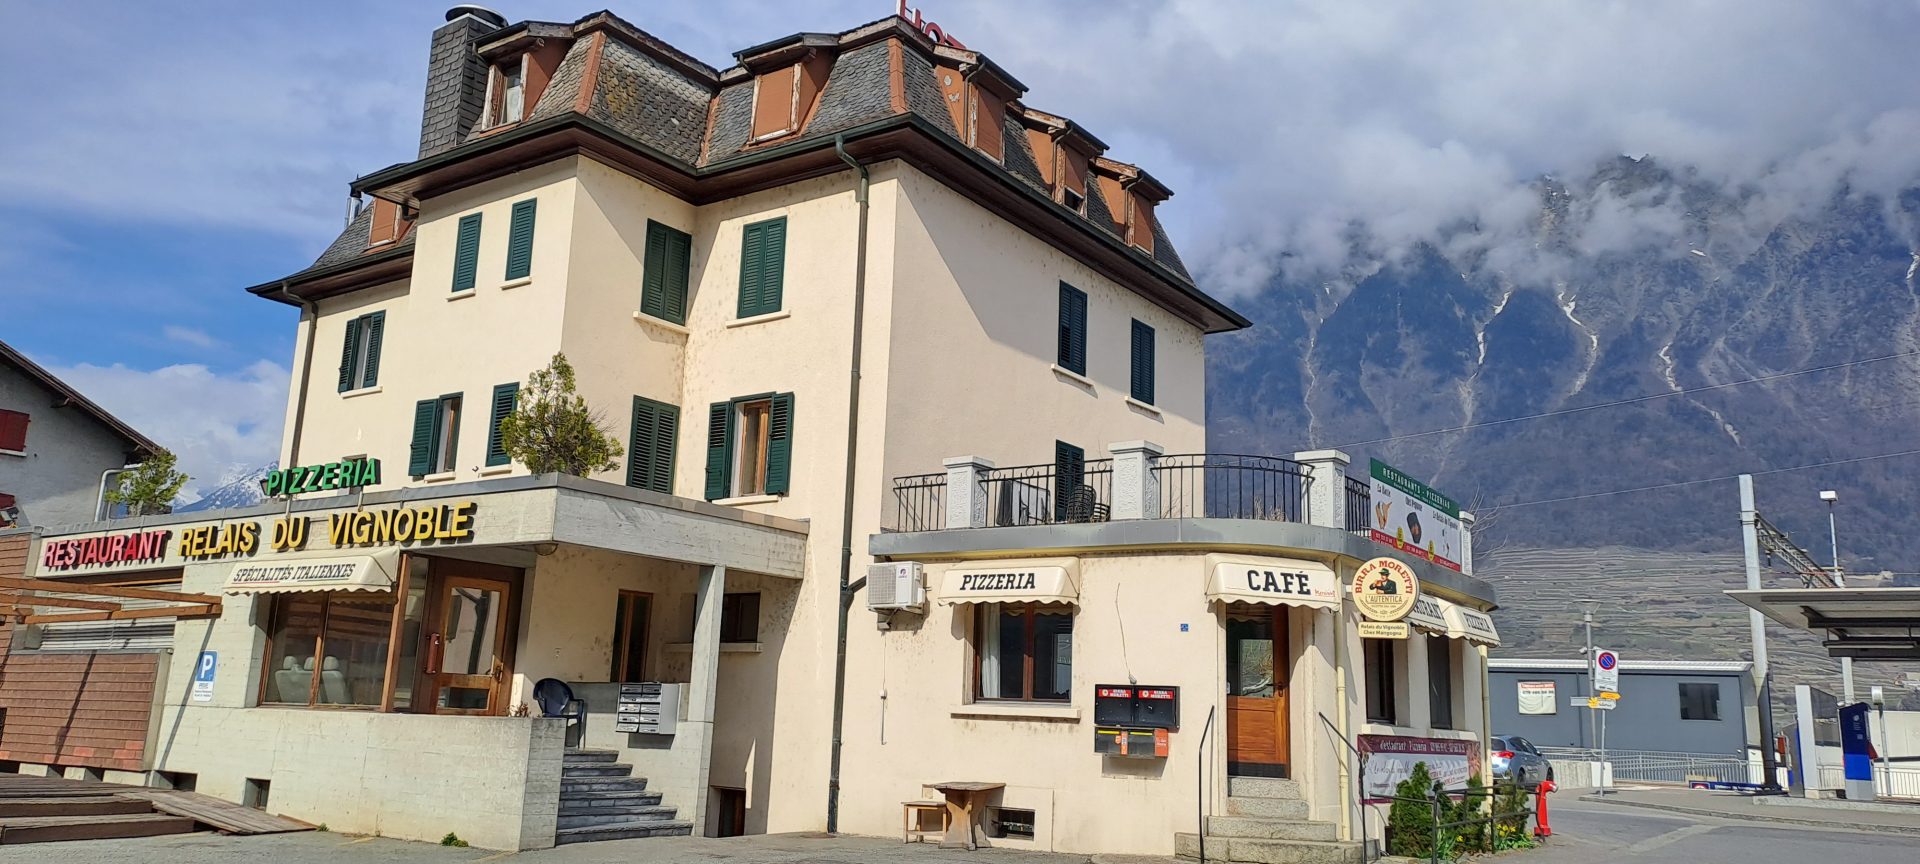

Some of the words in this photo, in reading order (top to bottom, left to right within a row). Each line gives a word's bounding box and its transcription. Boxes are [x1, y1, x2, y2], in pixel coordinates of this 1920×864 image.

[266, 458, 377, 497] PIZZERIA
[1383, 468, 1420, 494] RESTAURANTS
[1426, 490, 1450, 509] PIZZERIAS
[43, 530, 167, 567] RESTAURANT
[178, 521, 256, 556] RELAIS
[271, 516, 306, 549] DU
[328, 502, 472, 545] VIGNOBLE
[233, 563, 292, 582] SPÉCIALITÉS
[292, 563, 356, 580] ITALIENNES
[960, 573, 1035, 590] PIZZERIA
[1247, 570, 1311, 595] CAFÉ
[1355, 563, 1377, 593] BIRRA
[1379, 560, 1413, 594] MORETTI
[1366, 595, 1402, 603] L'AUTENTICA
[1463, 612, 1493, 633] PIZZERIA
[201, 654, 213, 679] P
